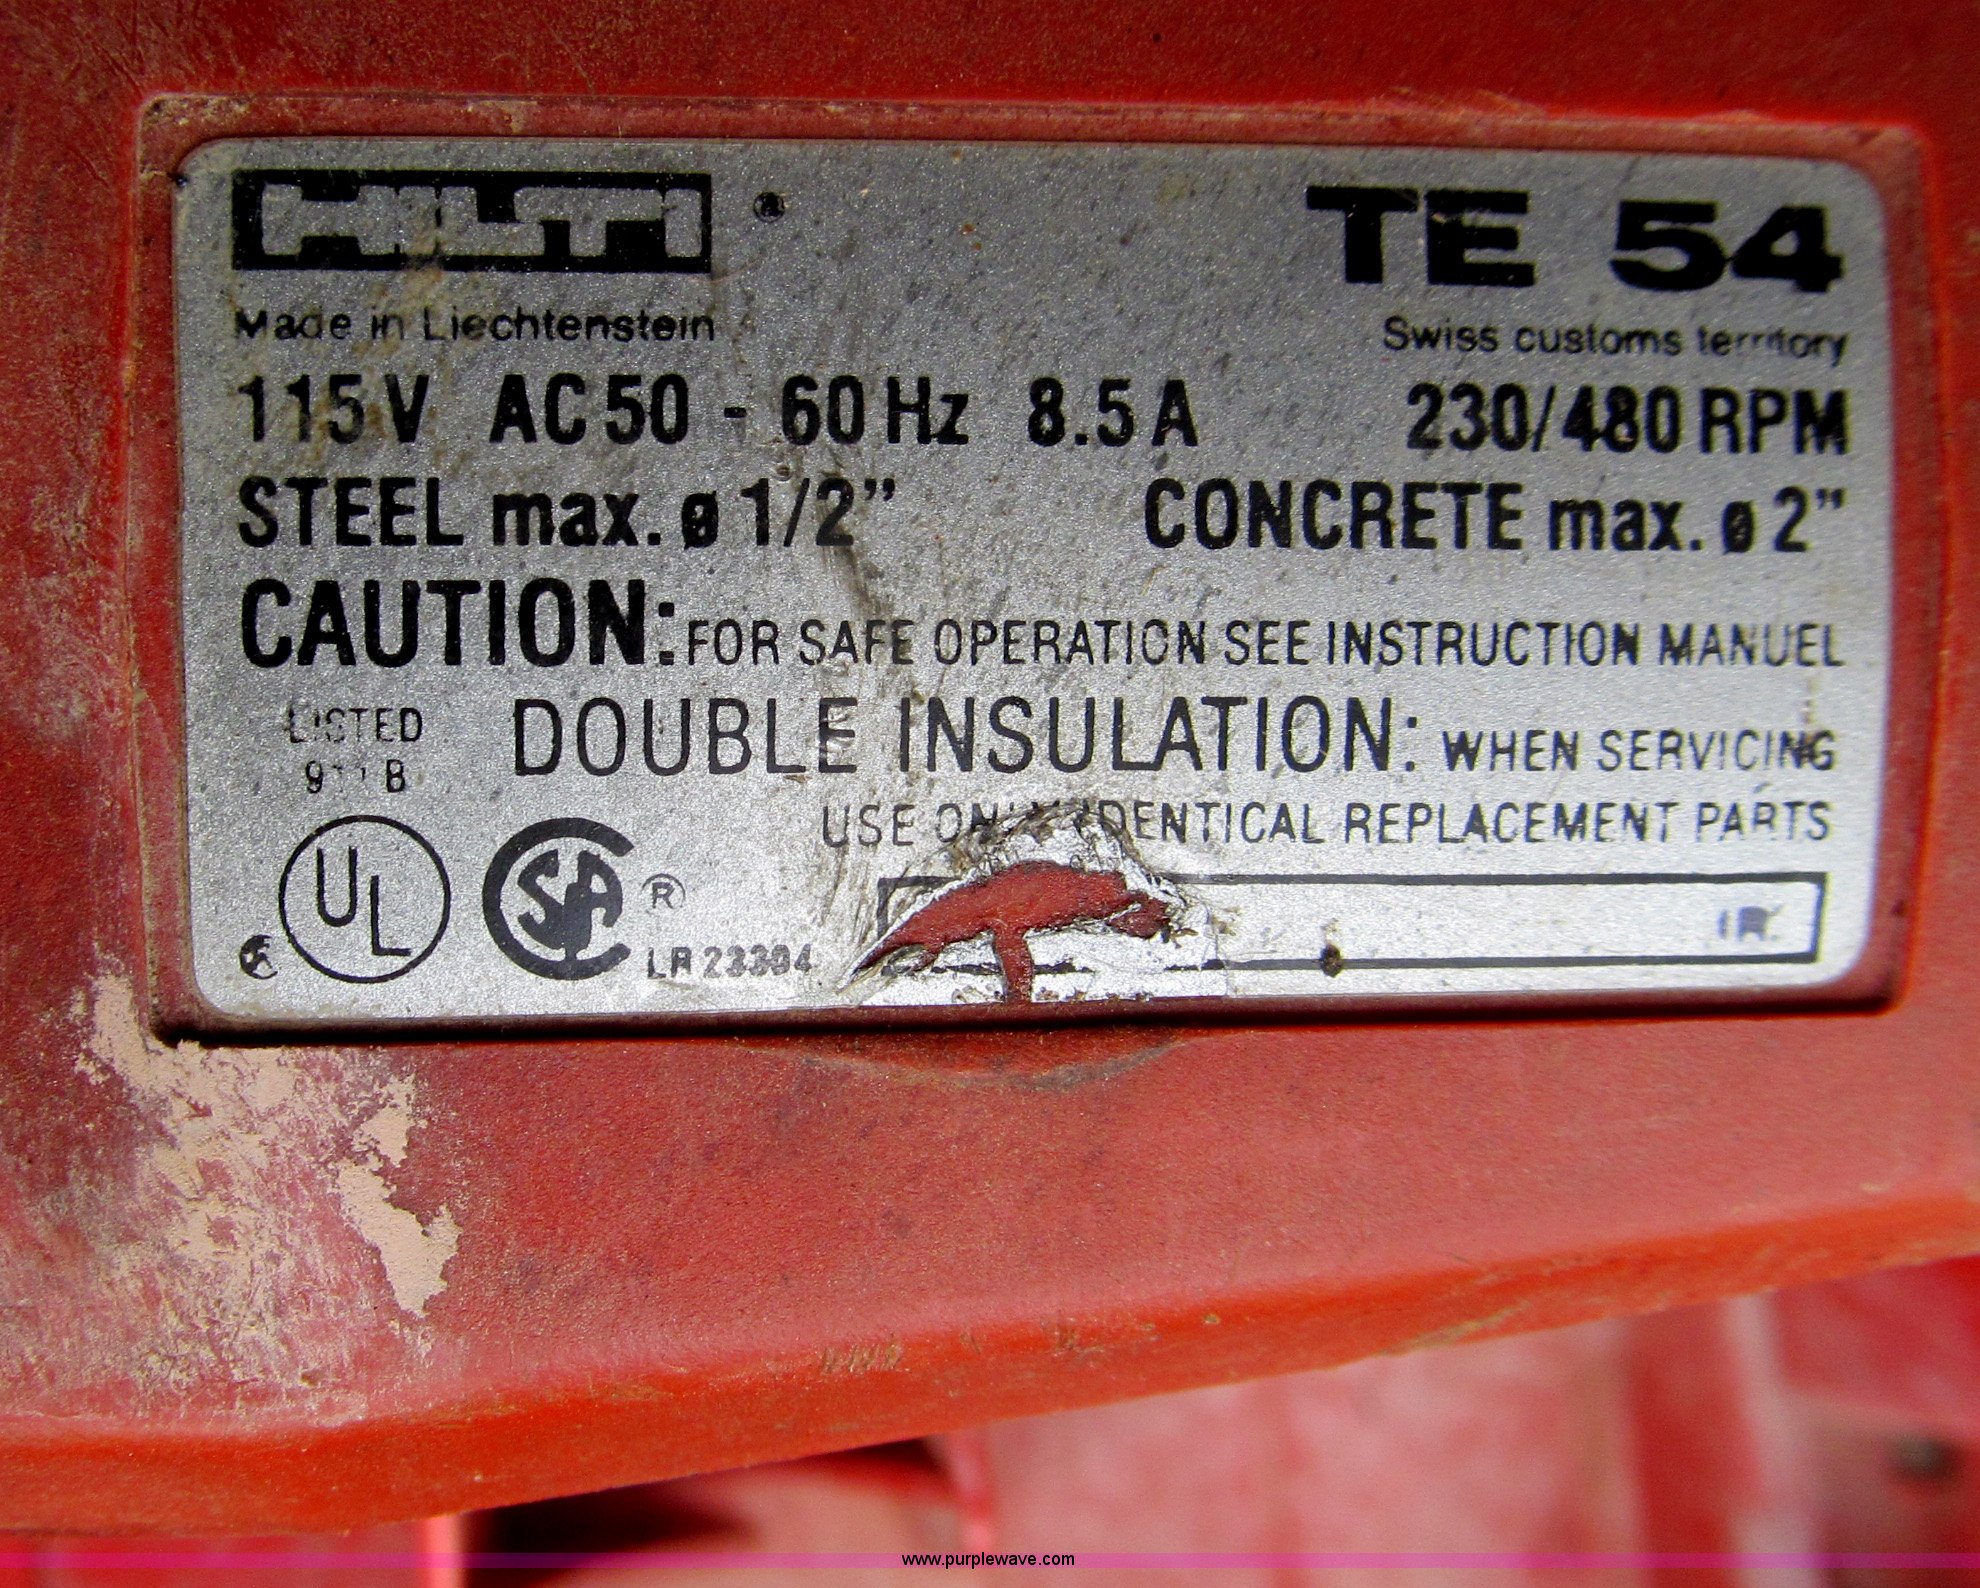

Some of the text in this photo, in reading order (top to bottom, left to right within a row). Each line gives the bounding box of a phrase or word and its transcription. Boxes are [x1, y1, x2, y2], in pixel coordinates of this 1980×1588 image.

[1306, 185, 1844, 293] TE 54
[236, 306, 715, 343] Made in Liechtenstein
[1383, 315, 1498, 352] Swiss
[1515, 322, 1681, 356] customs
[237, 373, 365, 444] 115
[387, 374, 429, 443] V
[782, 373, 866, 447] 60
[886, 376, 969, 445] Hz
[1027, 376, 1136, 447] 8.5
[1151, 379, 1198, 447] A
[1406, 382, 1849, 456] 230/480 RPM
[238, 476, 464, 549] STEEL
[491, 490, 663, 547] max.
[1145, 478, 1523, 551] CONCRETE
[1549, 497, 1704, 552] max.
[241, 577, 1846, 668] CAUTION: FOR SAFE OPERATION SEE INSTRUCTION MANUEL
[513, 696, 1837, 776] DOUBLE INSULATION: WHEN SERVICING
[822, 803, 915, 848] USE
[1344, 801, 1679, 845] REPLACEMENT
[1698, 799, 1831, 845] PARTS
